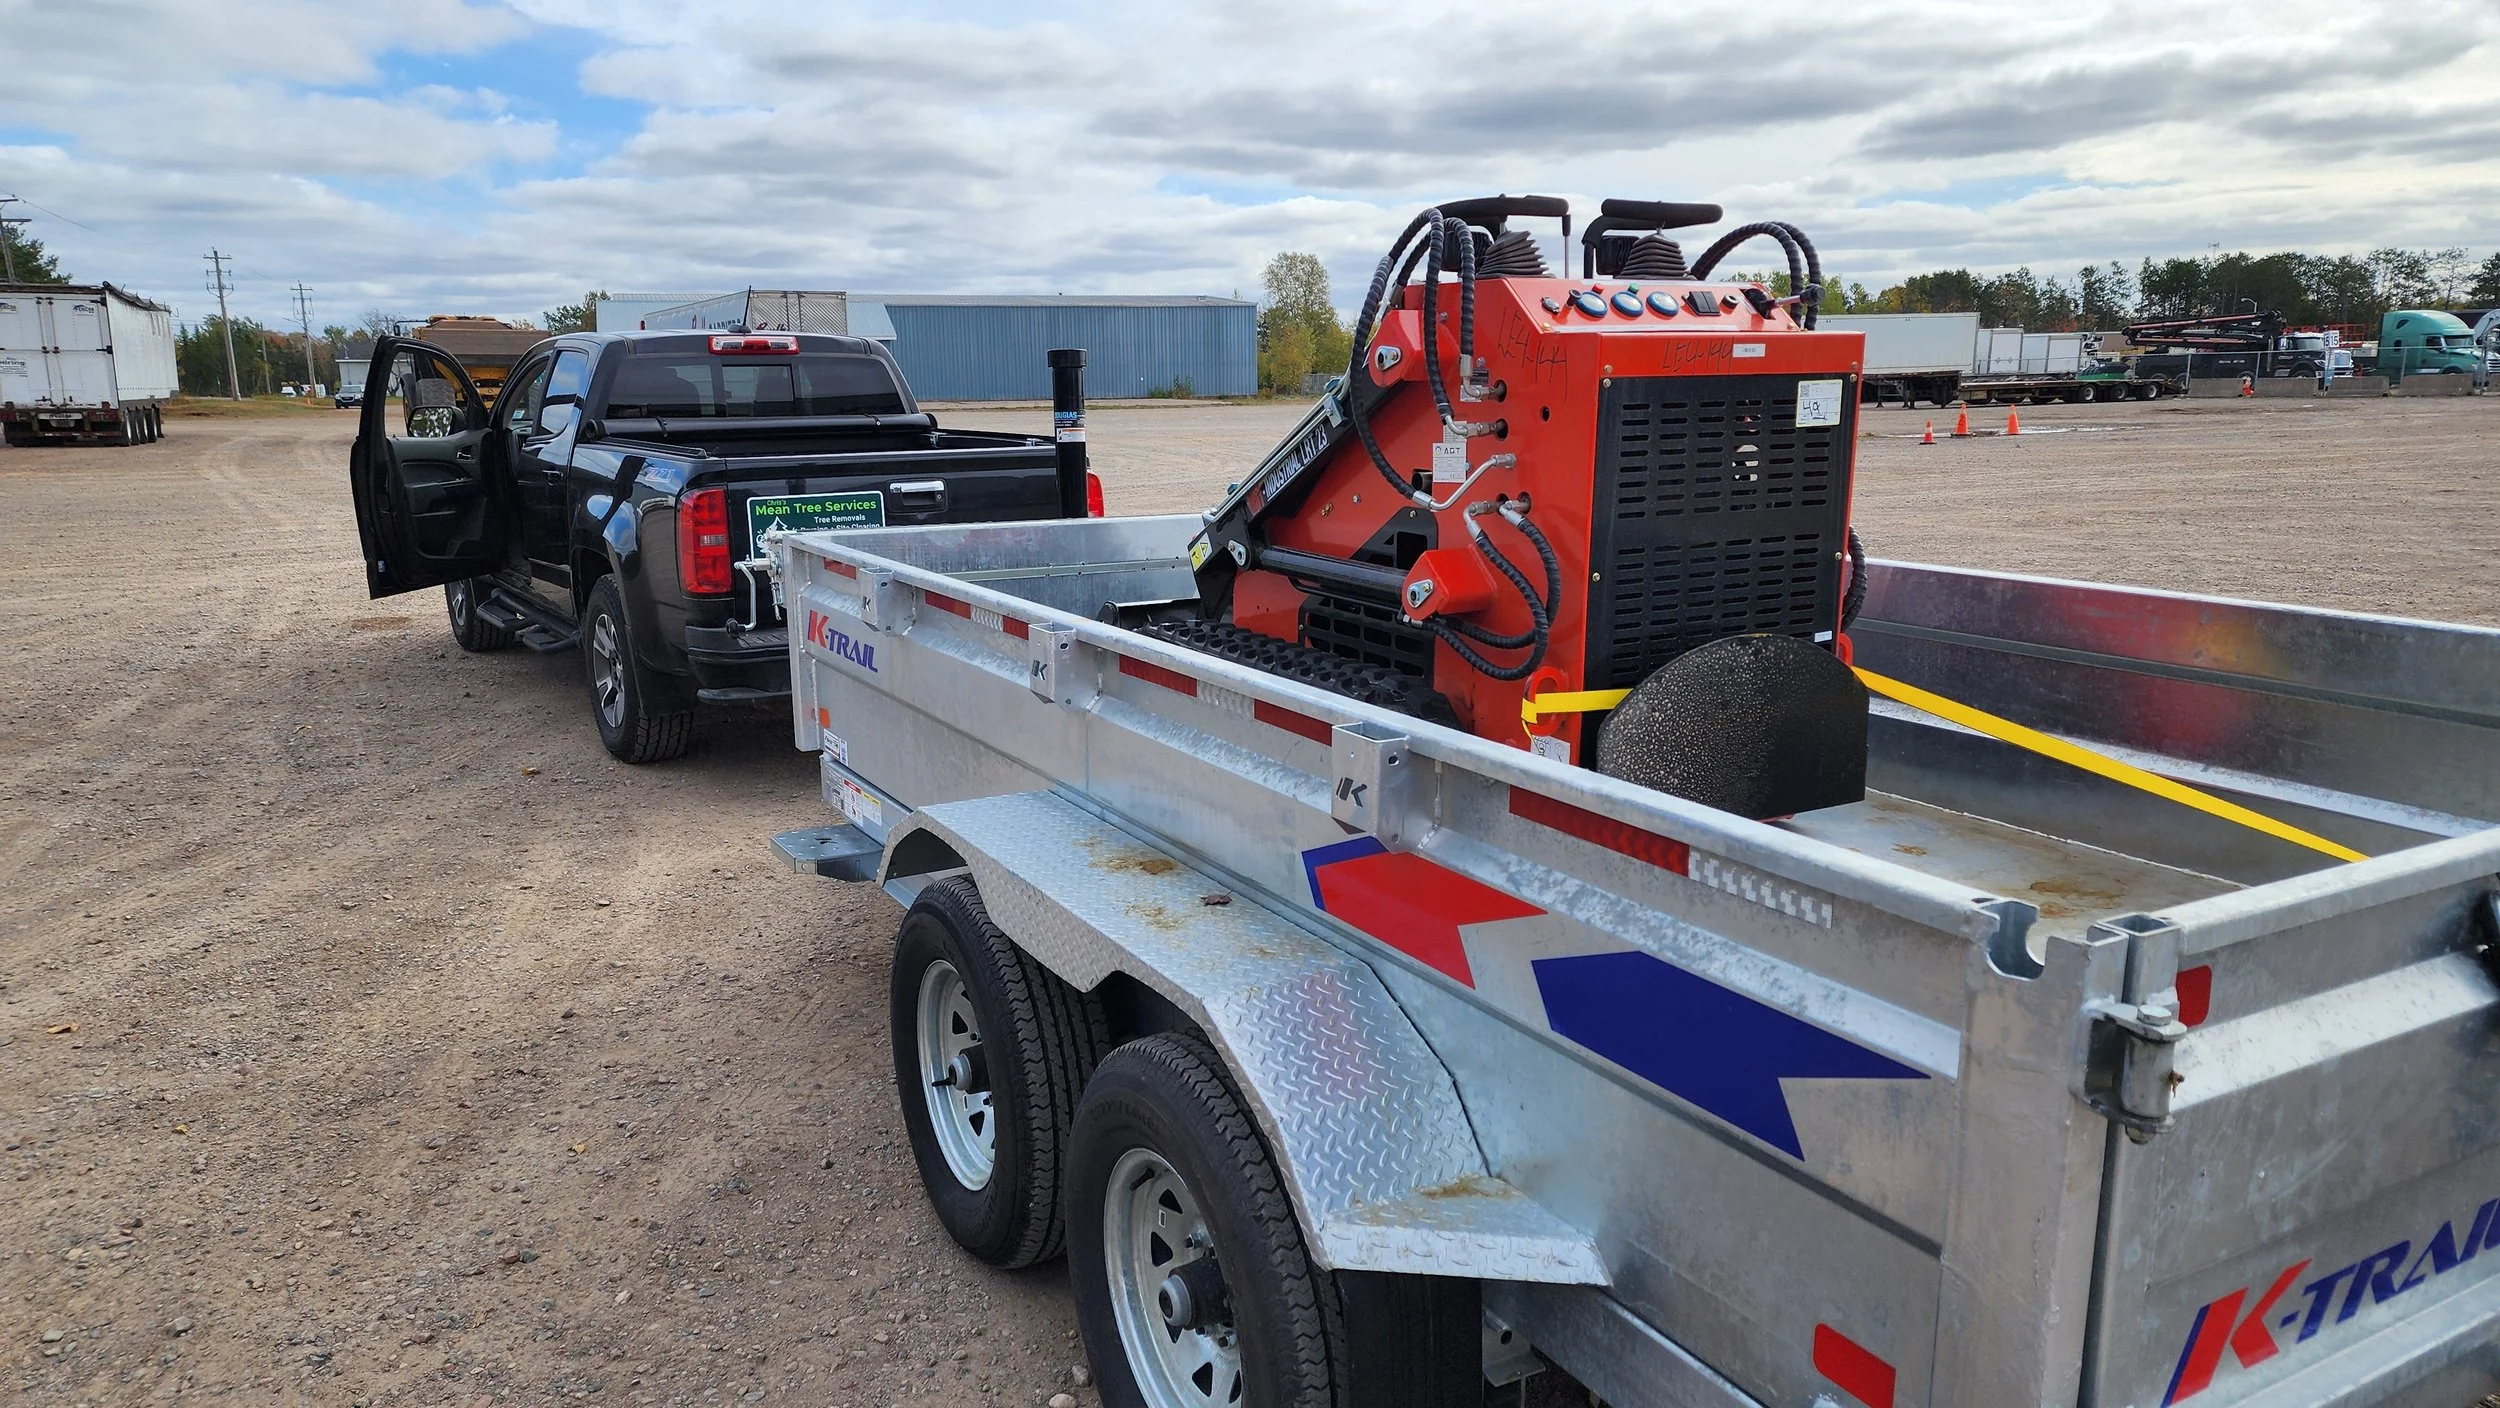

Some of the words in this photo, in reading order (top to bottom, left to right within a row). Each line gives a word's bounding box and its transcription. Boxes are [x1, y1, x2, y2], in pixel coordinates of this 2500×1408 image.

[1299, 431, 1317, 465] LRT
[1315, 423, 1329, 451] 23
[755, 504, 790, 516] Mean
[793, 502, 822, 514] Tree
[825, 499, 877, 512] Services
[813, 515, 831, 524] Tree
[831, 513, 866, 523] Removals
[807, 608, 879, 674] K-TRAIL
